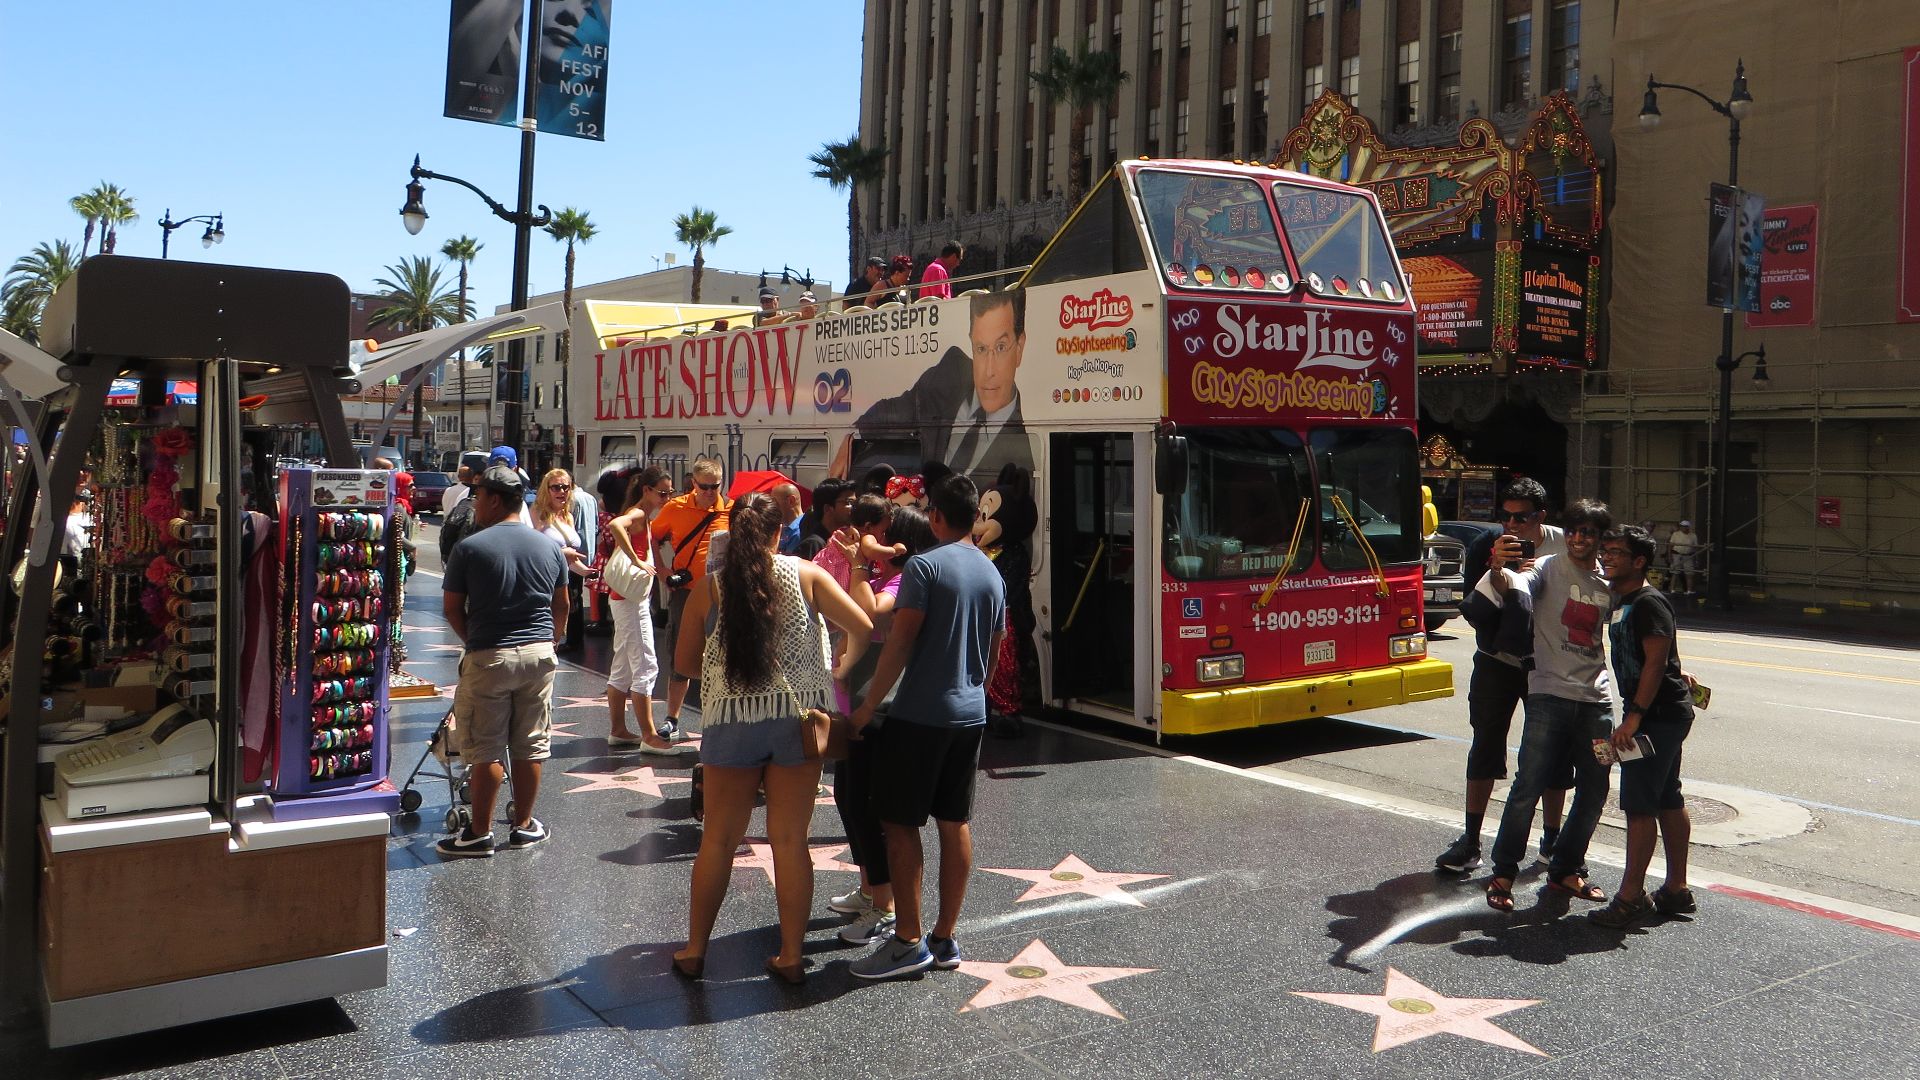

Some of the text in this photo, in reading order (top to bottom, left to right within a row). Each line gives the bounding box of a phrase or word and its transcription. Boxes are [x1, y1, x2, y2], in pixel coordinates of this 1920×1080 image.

[581, 43, 608, 61] AFI
[561, 59, 602, 79] FEST
[559, 79, 595, 98] NOV
[575, 122, 598, 138] 12
[1532, 270, 1558, 290] Capitan
[1430, 302, 1456, 311] QUESTIONS
[1456, 300, 1468, 308] CALL
[1769, 299, 1791, 310] abc
[815, 304, 939, 341] PREMIERES SEPT 8
[1426, 322, 1435, 330] THE
[1435, 321, 1456, 329] THEATRE
[1466, 320, 1483, 328] OFFICE
[1428, 331, 1437, 339] FOR
[815, 331, 939, 364] WEEKNIGHTS 11:35
[1056, 334, 1128, 356] CitySightseeing
[594, 323, 809, 421] LATE SHOW
[733, 361, 750, 379] with
[1192, 360, 1375, 418] CitySightseeing
[1242, 557, 1261, 571] RED
[1249, 574, 1382, 592] ww.StarLineTours.co
[1252, 604, 1380, 632] 1-800-959-3131
[998, 970, 1101, 997] HALLE BERRY
[1450, 1000, 1503, 1018] STEVEN
